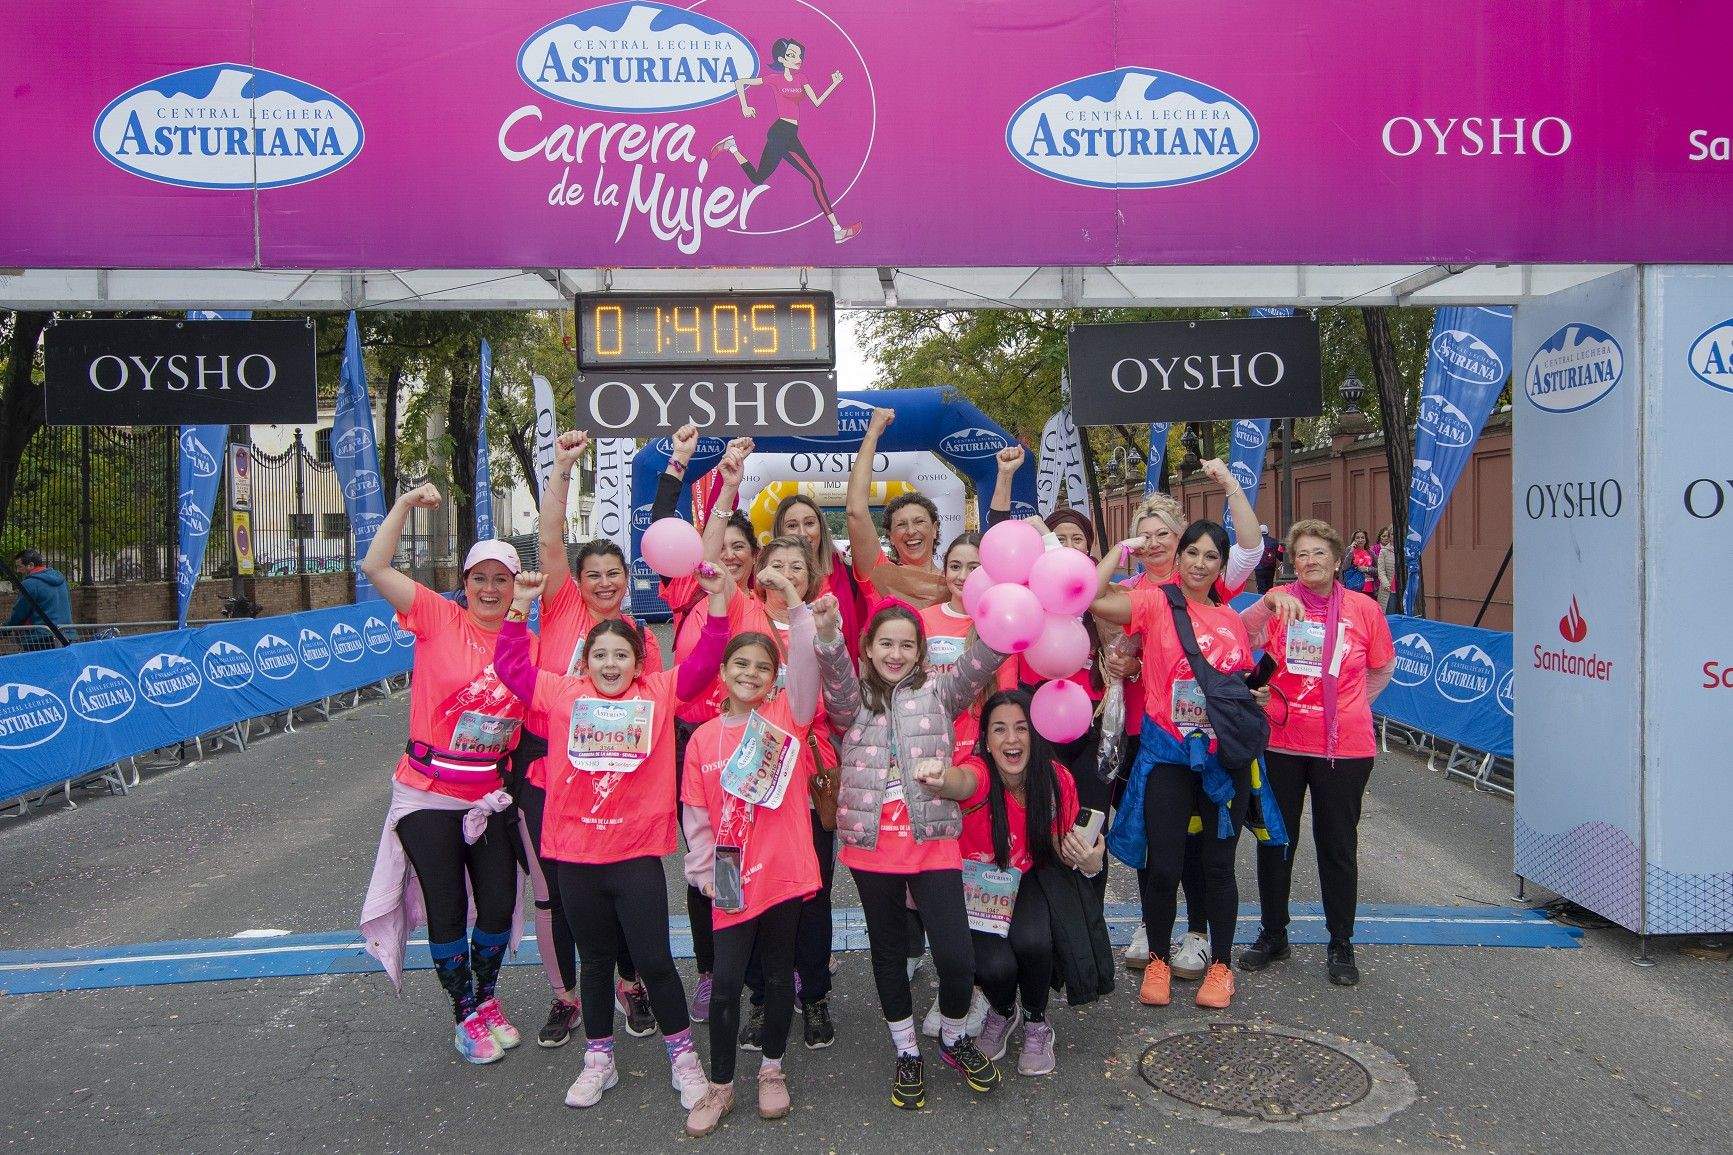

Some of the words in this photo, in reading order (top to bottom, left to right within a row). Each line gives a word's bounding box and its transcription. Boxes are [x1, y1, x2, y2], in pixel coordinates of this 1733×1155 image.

[536, 41, 740, 84] ASTURIANA
[573, 40, 648, 51] CENTRAL
[656, 40, 733, 51] LECHERA
[157, 107, 240, 120] CENTRAL
[249, 107, 335, 120] LECHERA
[1065, 110, 1144, 121] CENTRAL
[1152, 109, 1232, 121] LECHERA
[116, 109, 344, 157] ASTURIANA
[498, 105, 697, 164] Carrera
[1026, 112, 1239, 157] ASTURIANA
[1382, 116, 1573, 156] OYSHO
[1688, 129, 1733, 161] Sa
[548, 166, 585, 206] de
[593, 165, 620, 207] la
[615, 159, 771, 255] Mujer
[89, 353, 277, 392] OYSHO
[1111, 351, 1285, 394] OYSHO
[1531, 358, 1615, 397] ASTURIANA
[589, 380, 825, 429] OYSHO
[945, 440, 1003, 452] ASTURIANA
[1526, 478, 1622, 520] OYSHO
[258, 652, 297, 671] ASTURIANA
[1396, 655, 1429, 677] STURIANA
[1438, 661, 1488, 692] ASTURIANA
[1533, 644, 1613, 681] Santander
[145, 672, 200, 698] ASTURIANA
[0, 706, 64, 737] STURIANA
[594, 731, 624, 743] 016
